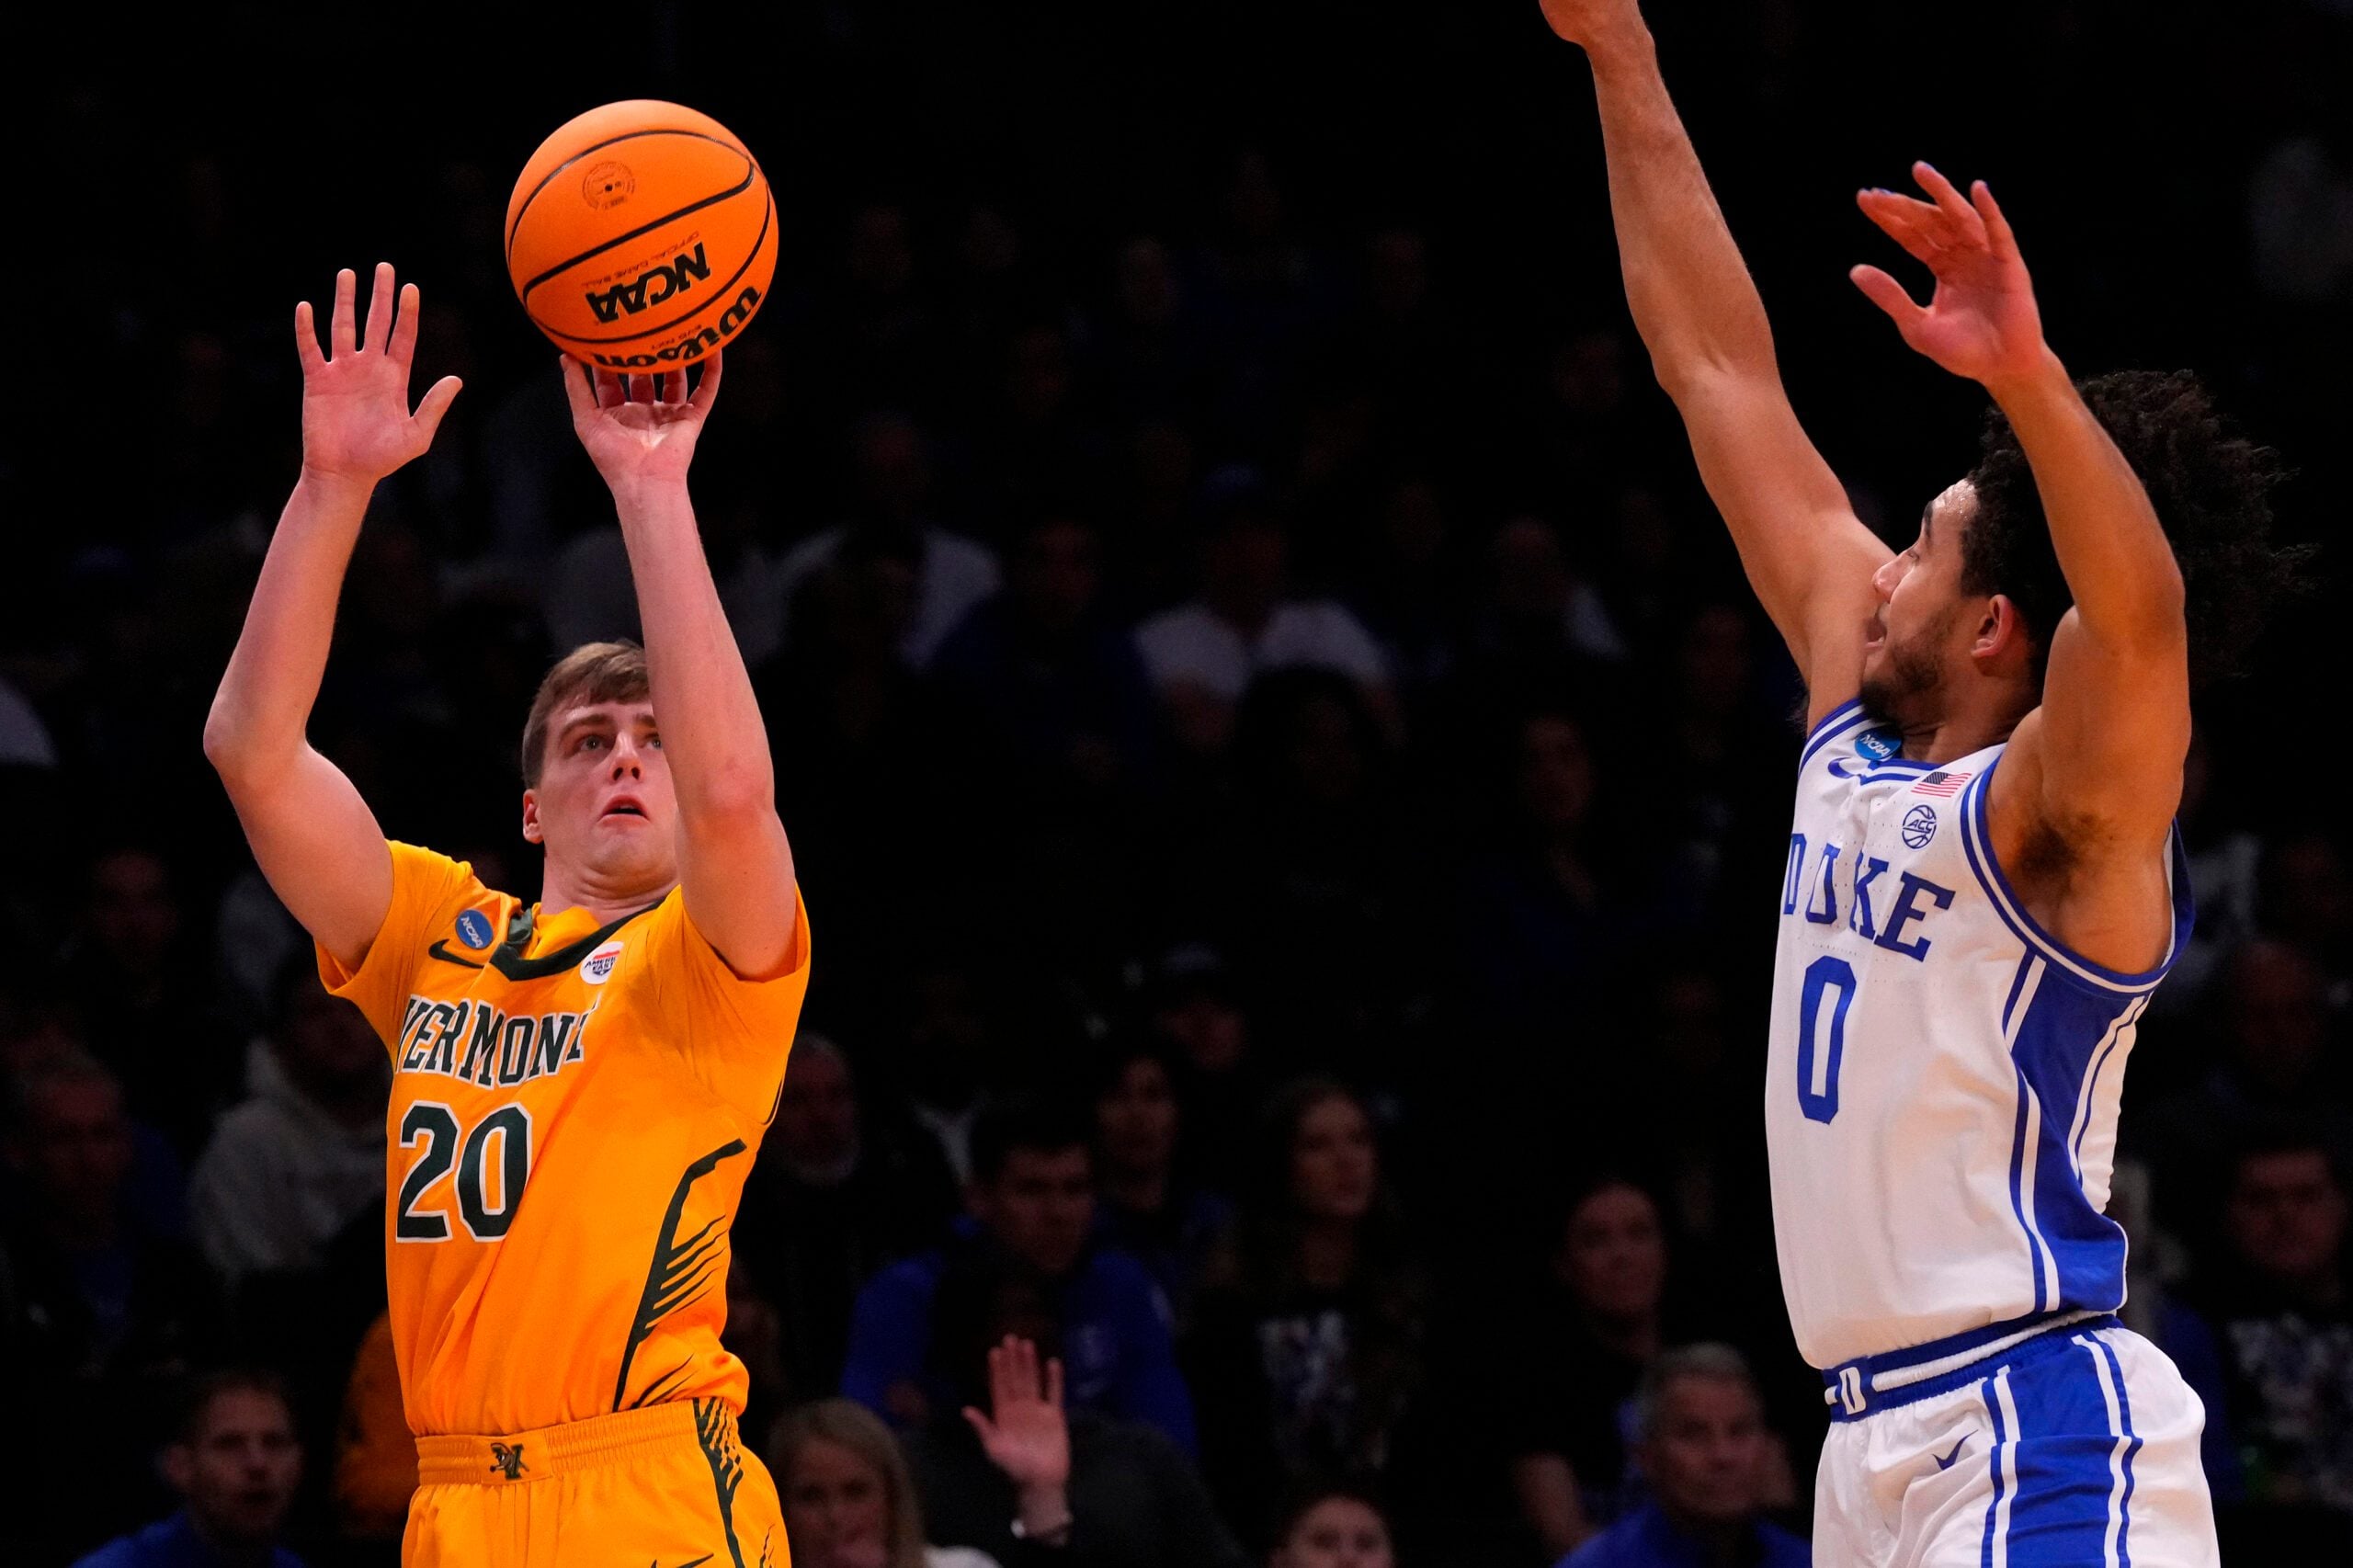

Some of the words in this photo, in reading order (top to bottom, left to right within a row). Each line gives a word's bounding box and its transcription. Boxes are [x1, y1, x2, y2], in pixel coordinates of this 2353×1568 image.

[585, 242, 711, 324] NCAA
[1860, 733, 1891, 756] NCAA
[1907, 819, 1936, 834] ACC
[1782, 833, 1956, 962] DUKE
[460, 916, 484, 949] NCAA
[584, 956, 616, 968] AMERI
[1797, 955, 1857, 1125] 0
[396, 1100, 532, 1243] 20
